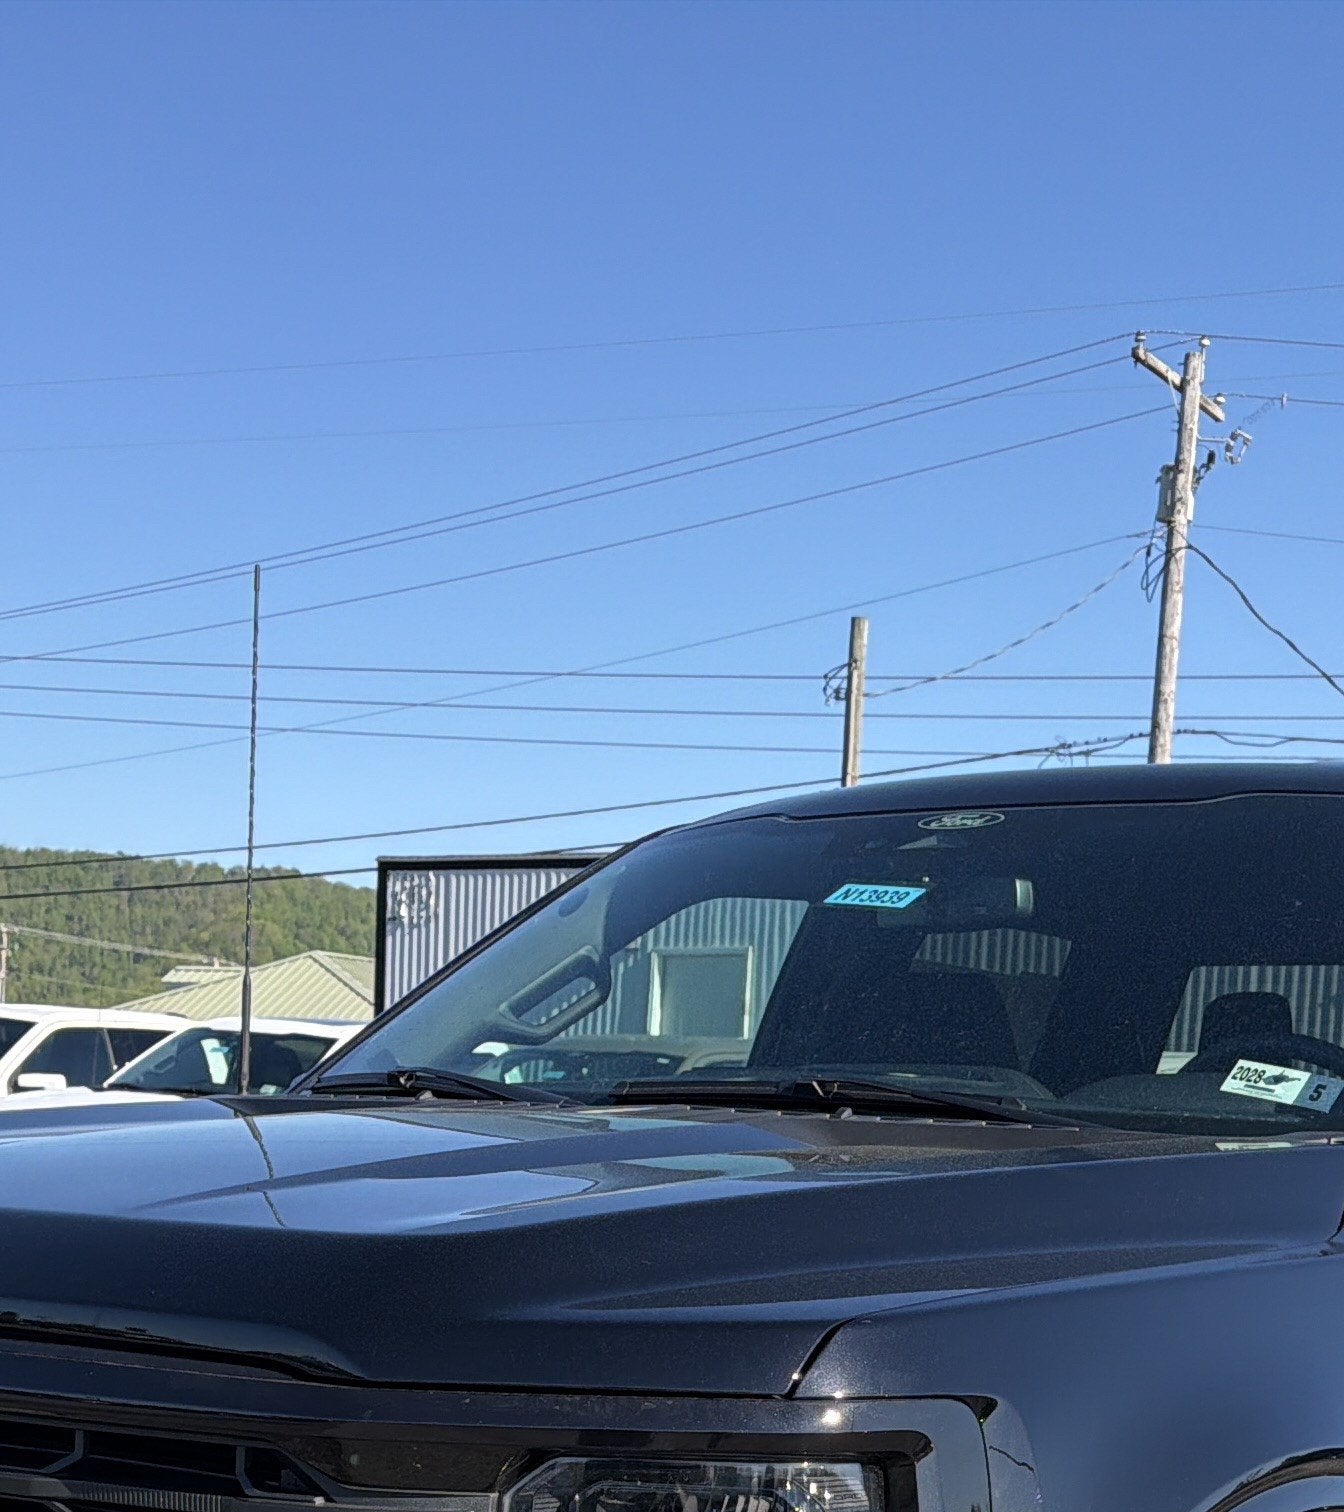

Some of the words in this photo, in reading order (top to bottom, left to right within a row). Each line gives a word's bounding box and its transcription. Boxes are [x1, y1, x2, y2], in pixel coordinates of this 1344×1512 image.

[929, 814, 993, 828] Ford
[834, 887, 911, 905] N13939
[1231, 1065, 1267, 1084] 2028
[1308, 1083, 1327, 1102] 5
